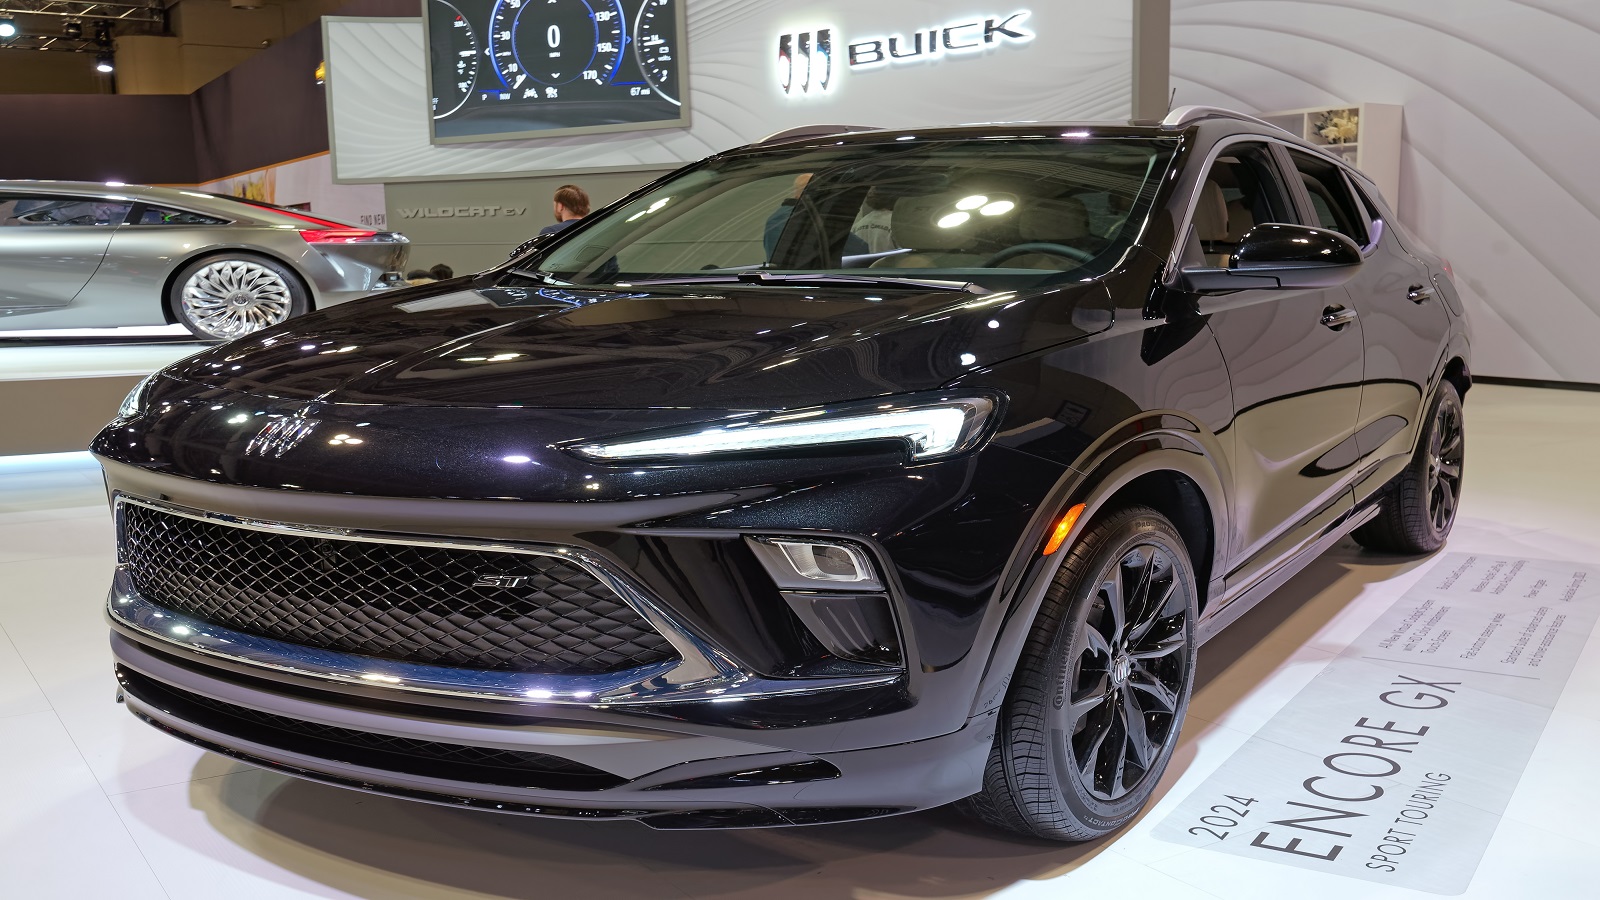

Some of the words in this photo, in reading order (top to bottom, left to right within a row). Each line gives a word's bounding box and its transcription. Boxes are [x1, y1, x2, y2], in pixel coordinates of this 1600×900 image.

[595, 11, 610, 21] 130
[500, 31, 510, 40] 30
[547, 25, 560, 48] 0
[848, 11, 1032, 67] BUICK
[597, 42, 612, 52] 150
[508, 62, 518, 72] 10
[582, 70, 598, 80] 170
[630, 88, 641, 96] 67
[398, 206, 502, 219] WILDCAT
[506, 207, 527, 216] EV
[360, 214, 373, 226] FIND
[374, 214, 386, 225] NEW
[472, 574, 530, 588] ST
[1250, 716, 1430, 862] ENCORE
[1378, 674, 1462, 710] GX
[1188, 794, 1259, 841] 2024
[1366, 828, 1416, 872] SPORT
[1394, 772, 1452, 826] TOURING
